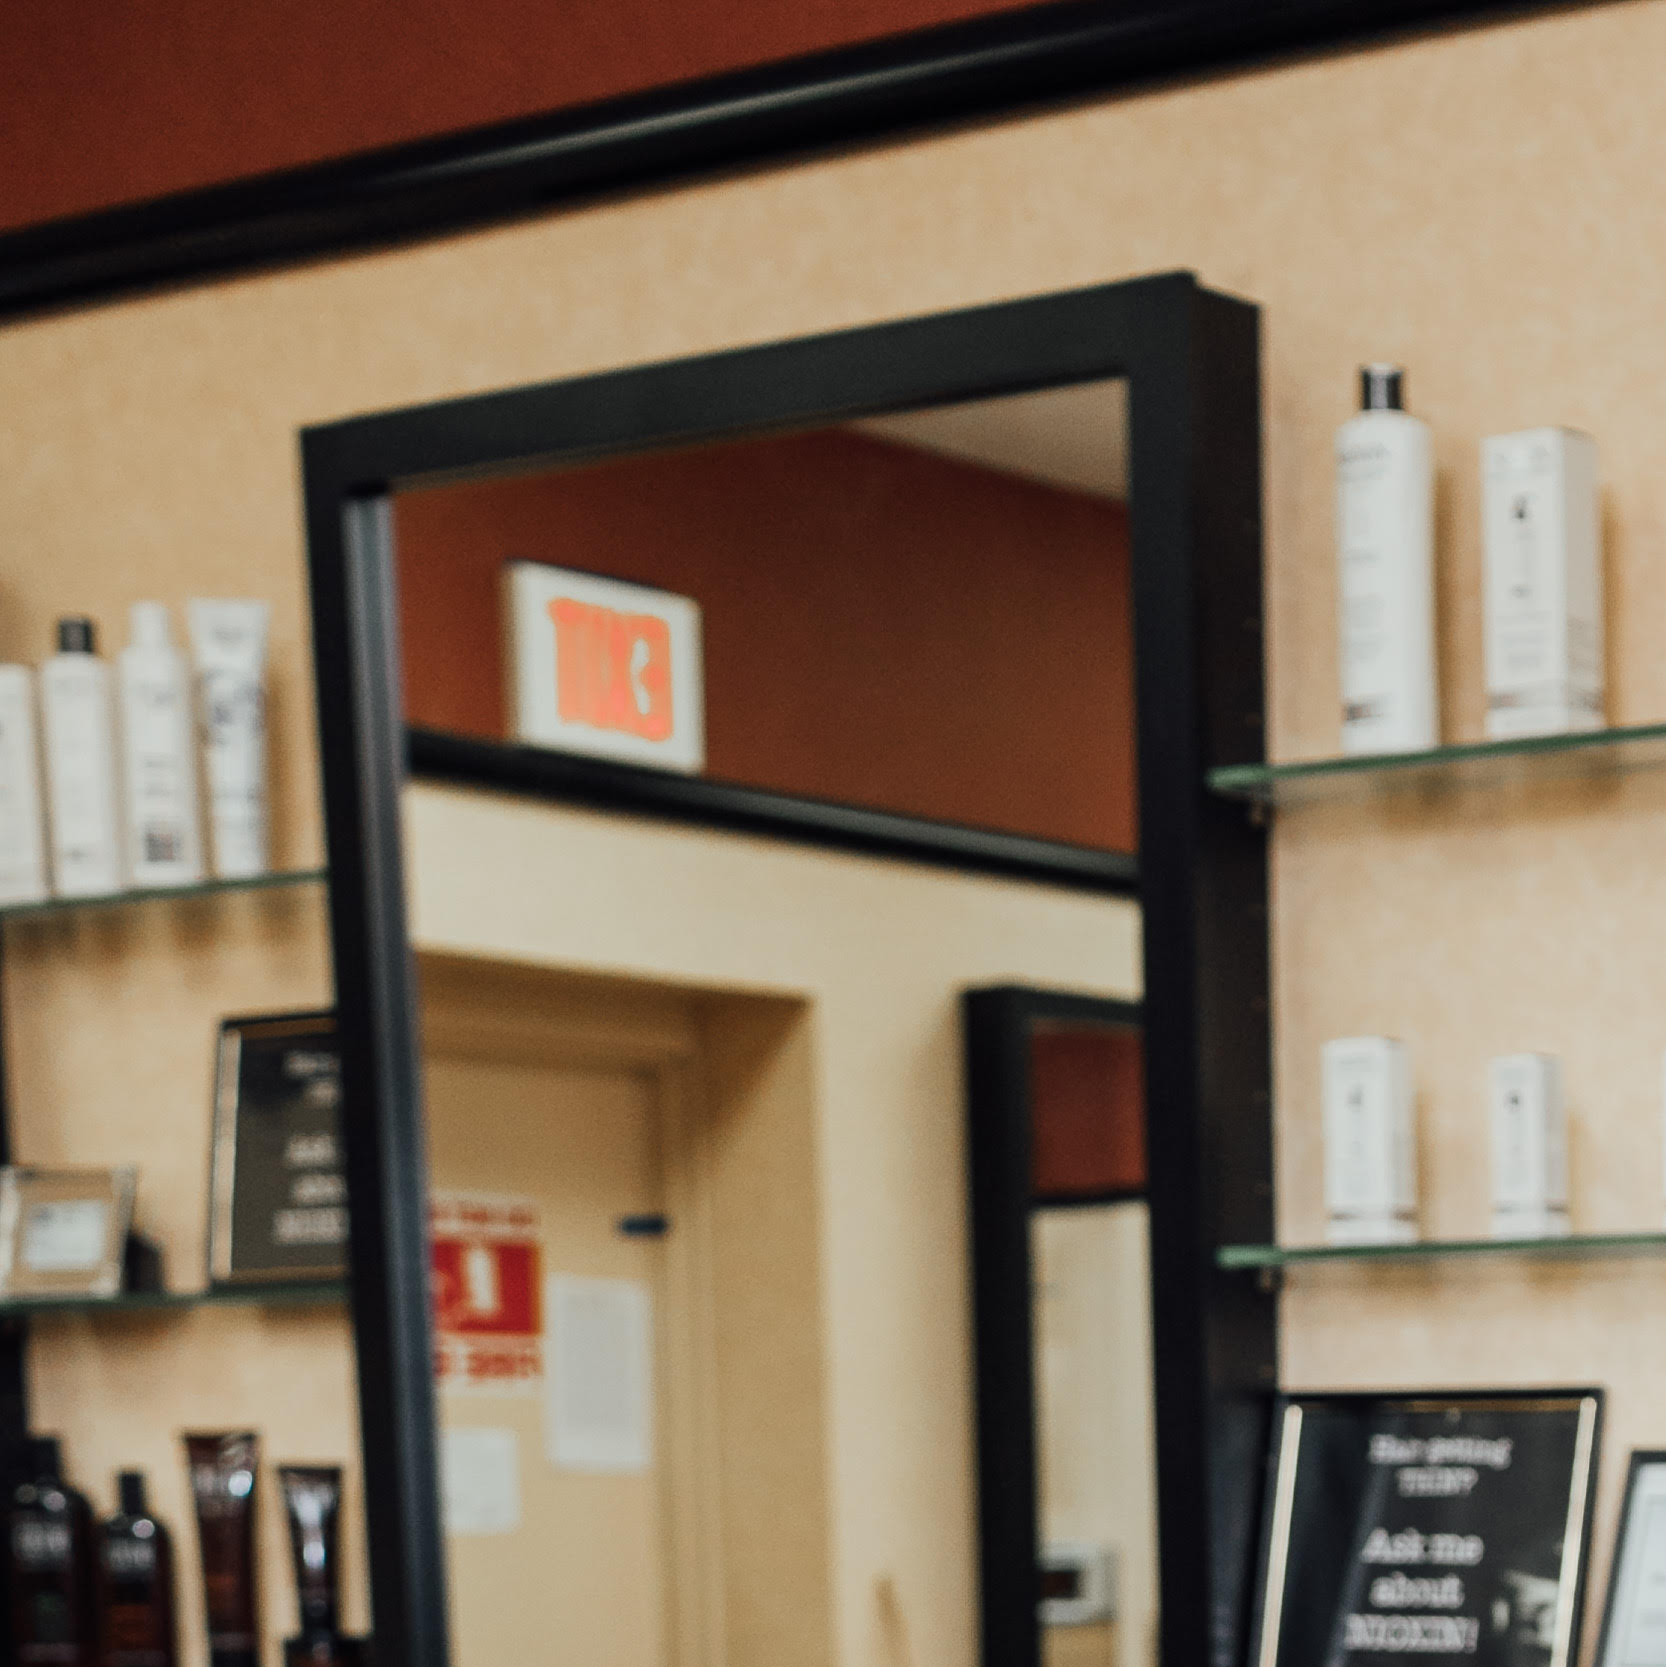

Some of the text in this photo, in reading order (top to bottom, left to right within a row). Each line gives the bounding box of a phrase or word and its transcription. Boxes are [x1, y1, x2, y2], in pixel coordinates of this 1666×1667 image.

[1361, 1527, 1485, 1565] Ask me
[1369, 1571, 1465, 1609] about
